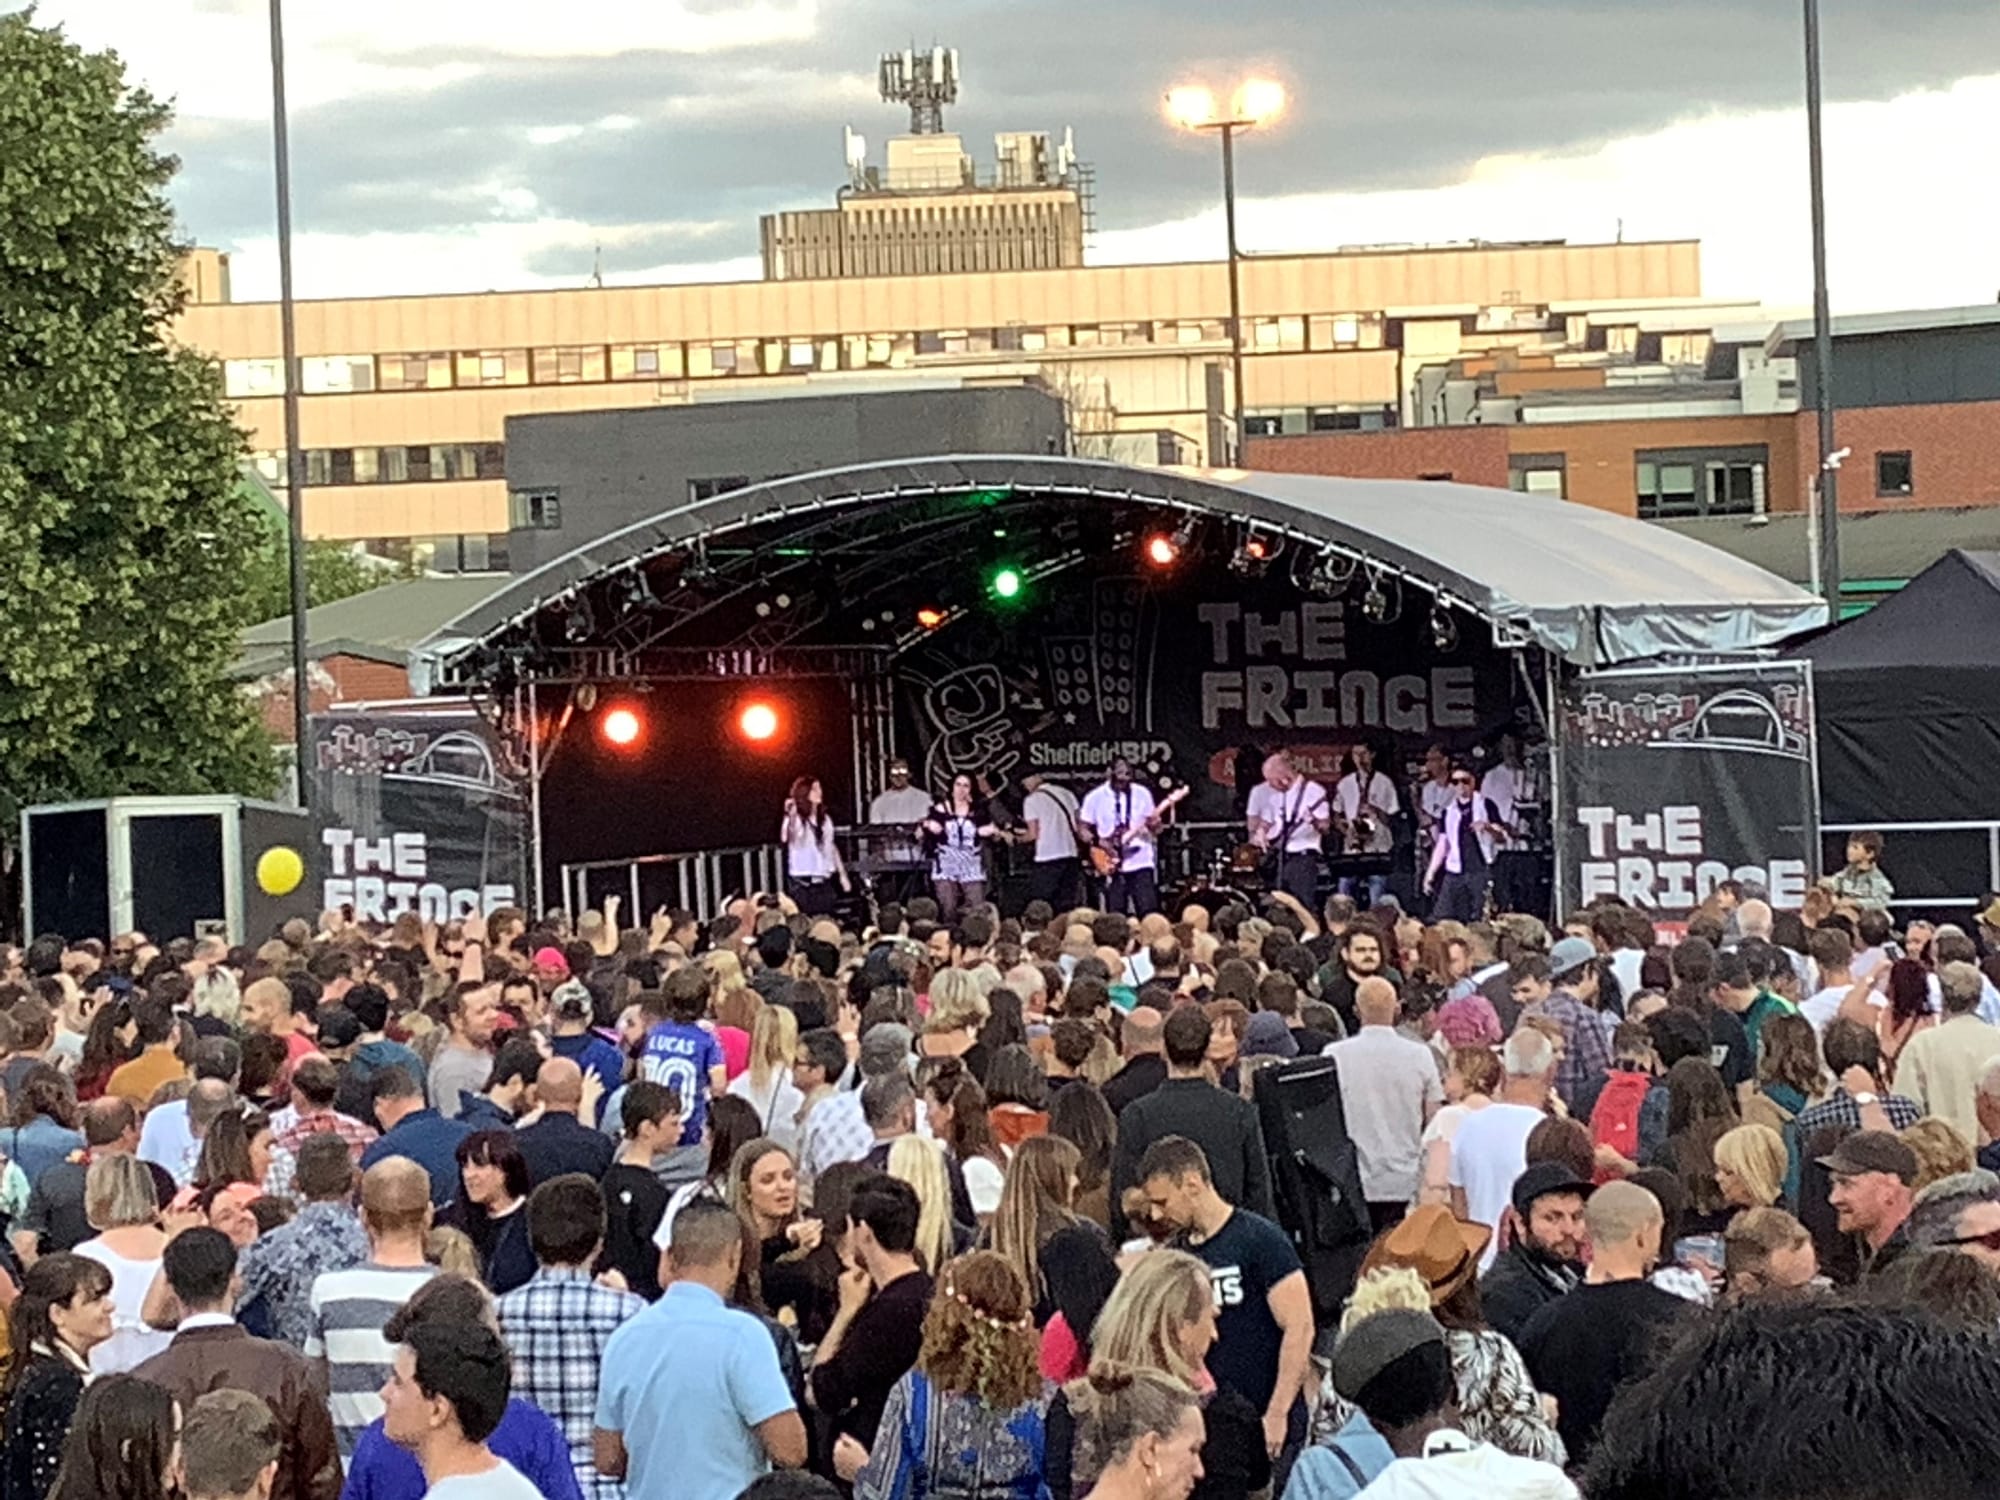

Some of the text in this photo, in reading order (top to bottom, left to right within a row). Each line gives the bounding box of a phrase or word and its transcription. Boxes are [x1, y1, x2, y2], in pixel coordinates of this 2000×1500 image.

[1198, 602, 1346, 663] THE
[1202, 665, 1476, 733] FRINGE
[323, 828, 427, 878] THE
[1577, 805, 1702, 857] THE
[649, 1035, 695, 1055] LUCAS
